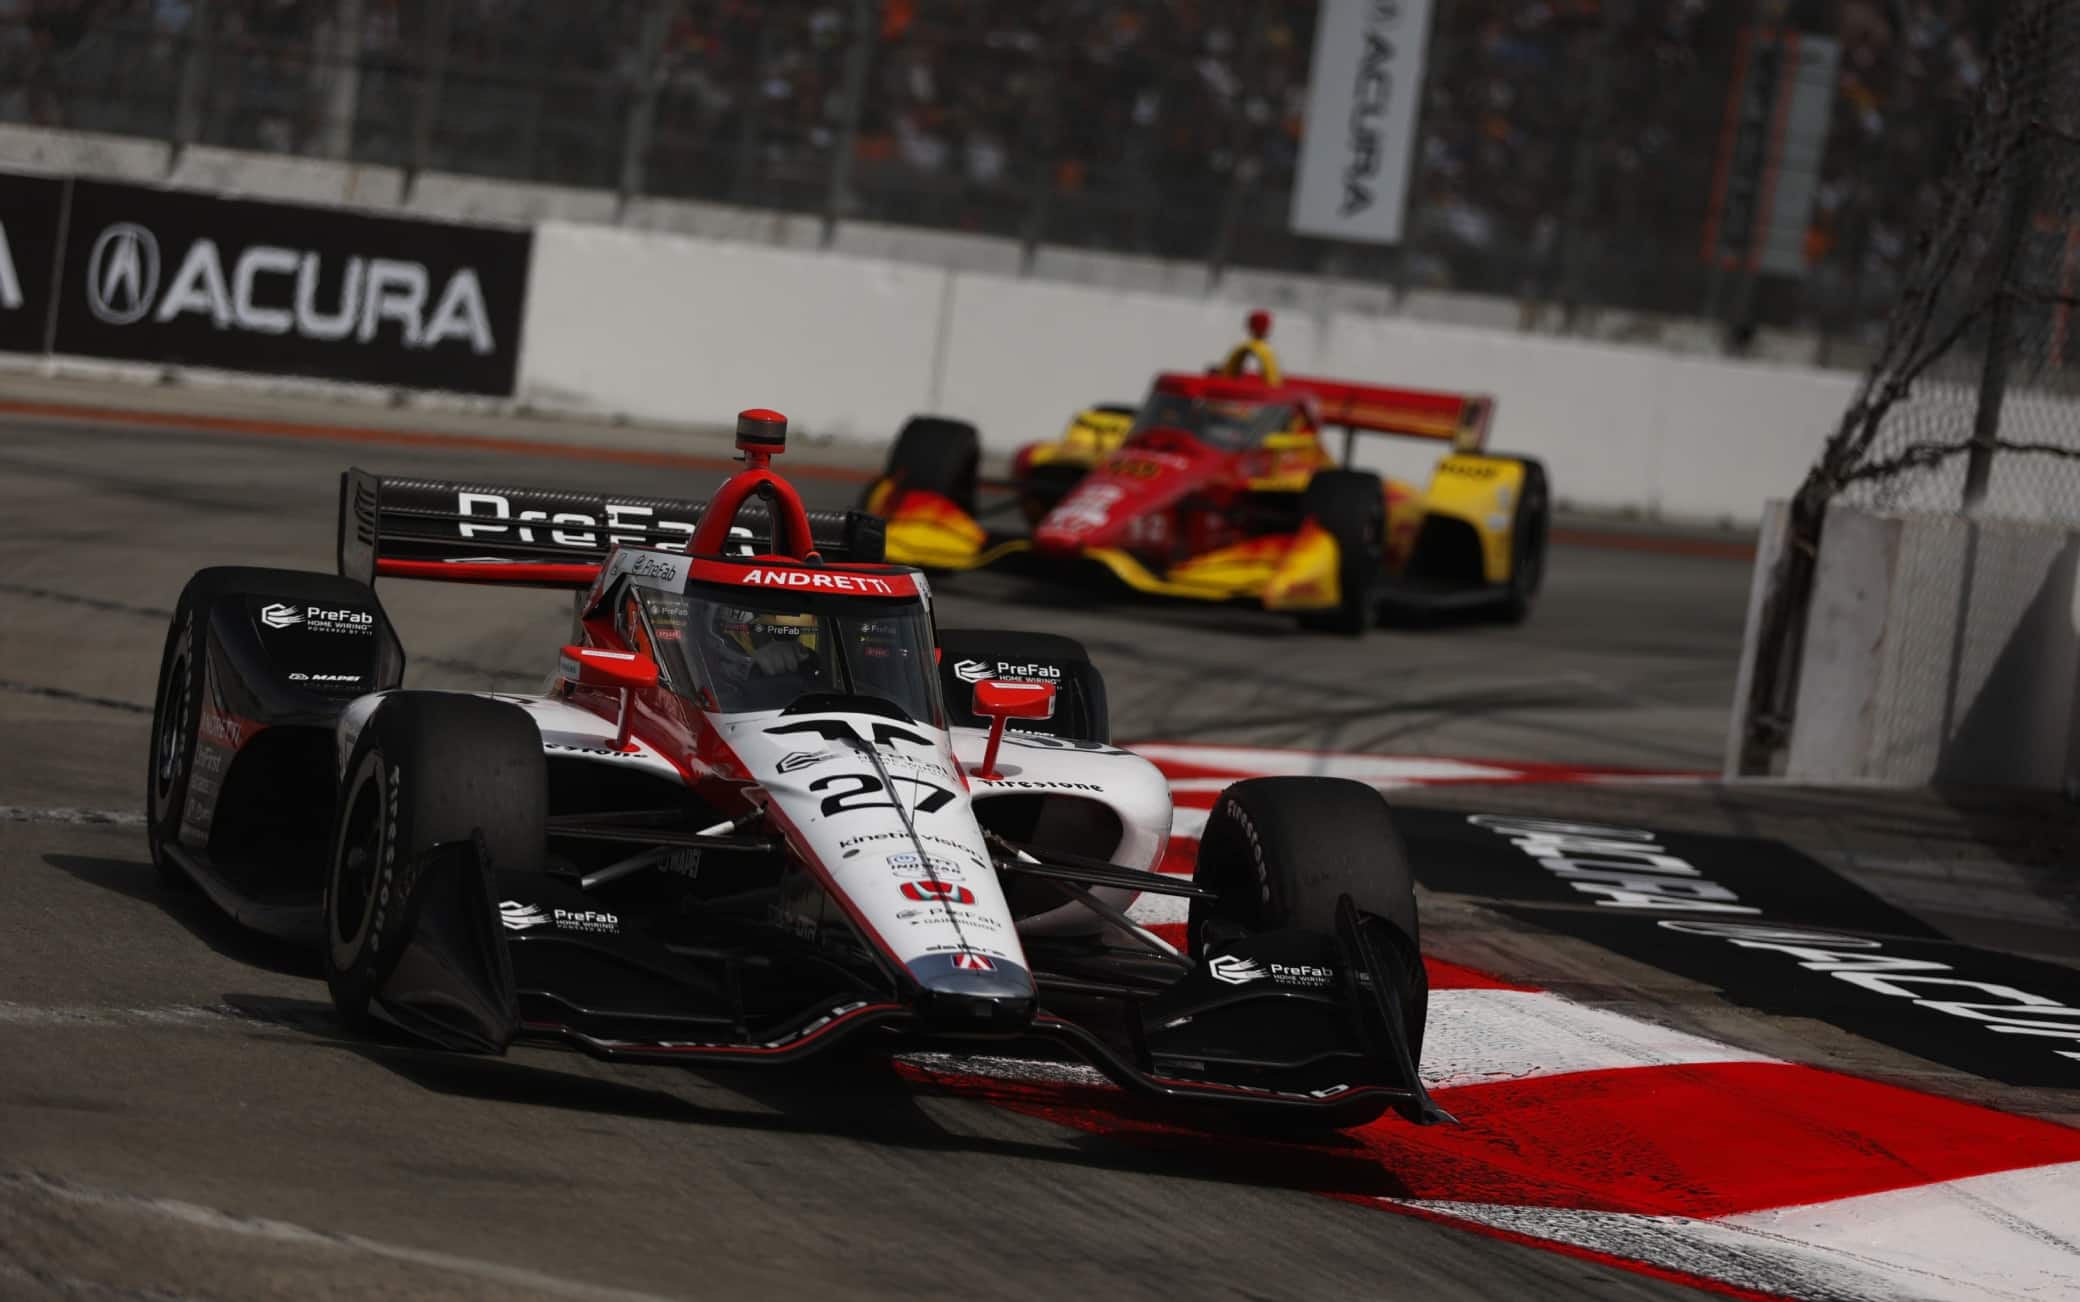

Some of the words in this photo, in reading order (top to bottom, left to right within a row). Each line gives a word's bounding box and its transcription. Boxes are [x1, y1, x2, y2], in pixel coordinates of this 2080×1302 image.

[1340, 30, 1397, 219] ACURA
[155, 237, 496, 355] ACURA
[643, 559, 677, 582] PreFab
[742, 570, 892, 594] ANDRETTI
[307, 606, 373, 624] PreFab
[307, 620, 333, 628] HOME
[335, 623, 368, 631] WIRING
[767, 625, 800, 636] PreFab
[997, 661, 1061, 679] PreFab
[809, 774, 956, 817] 27
[839, 830, 915, 849] kinetic
[920, 832, 984, 861] vision
[1227, 799, 1270, 905] Firestone
[552, 908, 618, 924] PreFab
[1269, 963, 1333, 978] PreFab
